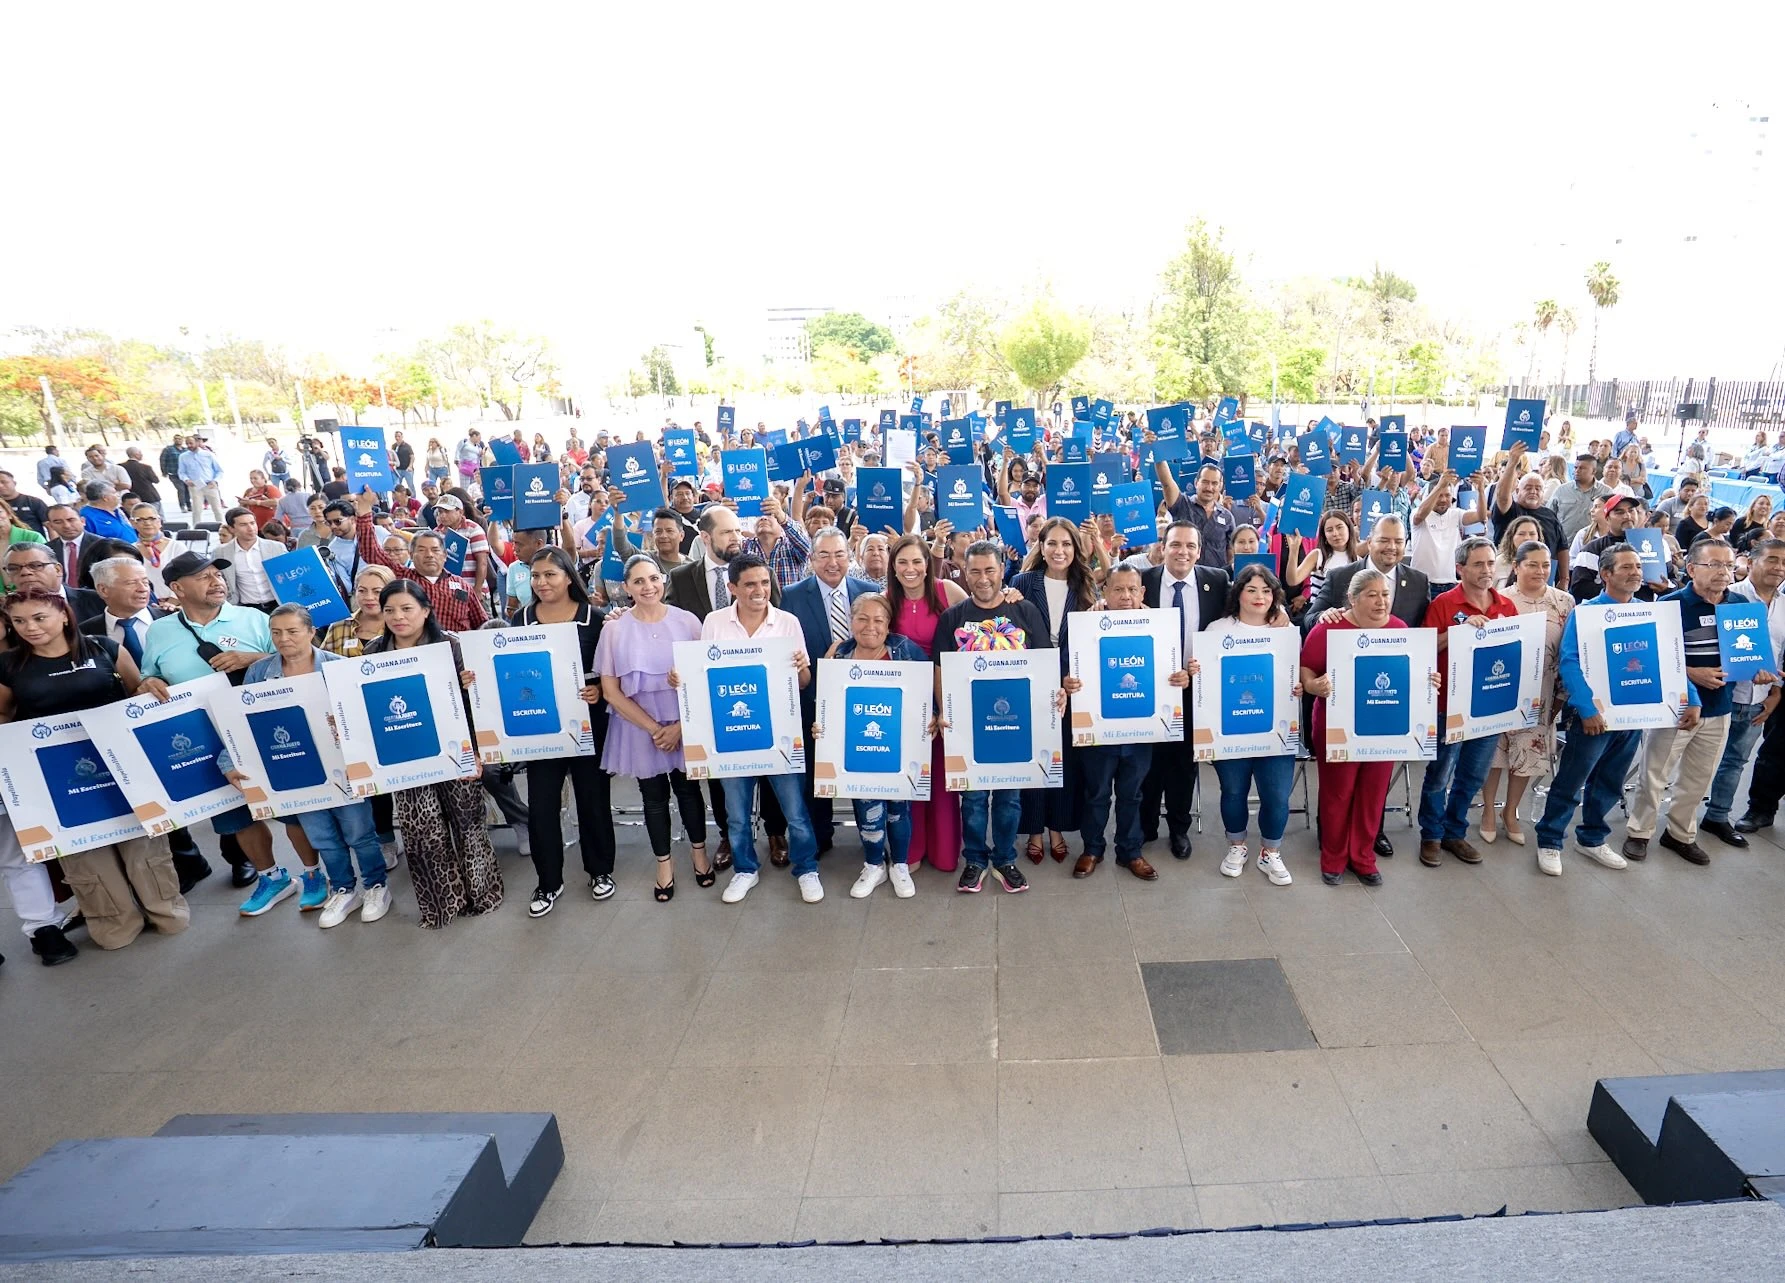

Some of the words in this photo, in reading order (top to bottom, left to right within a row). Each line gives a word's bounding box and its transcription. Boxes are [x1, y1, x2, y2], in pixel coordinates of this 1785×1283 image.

[356, 438, 378, 449] LEÓN
[736, 462, 757, 471] LEÓN
[306, 599, 331, 610] CRITURA
[967, 622, 977, 631] 35
[1733, 618, 1758, 627] LEÓN
[1487, 625, 1520, 634] GUANAJUATO
[219, 637, 237, 646] 242
[508, 634, 546, 642] GUANAJUATO
[1623, 640, 1648, 650] LEÓN
[376, 657, 418, 669] GUANAJUATO
[1119, 655, 1144, 665] LEÓN
[1730, 655, 1763, 663] ESCRITURA
[1620, 678, 1652, 686] ESCRITURA
[729, 683, 757, 693] LEÓN
[255, 687, 294, 700] GUANAJUATO
[144, 691, 192, 710] GUAJUATO
[864, 703, 892, 713] LEÓN
[1627, 715, 1662, 724] Escritura
[53, 721, 82, 732] GUANA
[726, 723, 761, 732] ESCRITURA
[1482, 721, 1513, 732] Escritura
[511, 747, 522, 756] Mi
[525, 745, 564, 754] Escritura
[171, 762, 181, 771] Mi
[182, 754, 214, 767] Escritura
[719, 763, 730, 771] Mi
[386, 777, 401, 786] Mi
[402, 768, 444, 784] Escritura
[80, 780, 116, 792] Escritura
[184, 809, 198, 820] Mi
[200, 794, 245, 816] Escritura
[280, 800, 292, 810] Mi
[294, 795, 332, 808] Escritura
[71, 837, 88, 847] Mi
[90, 825, 144, 844] Escritura
